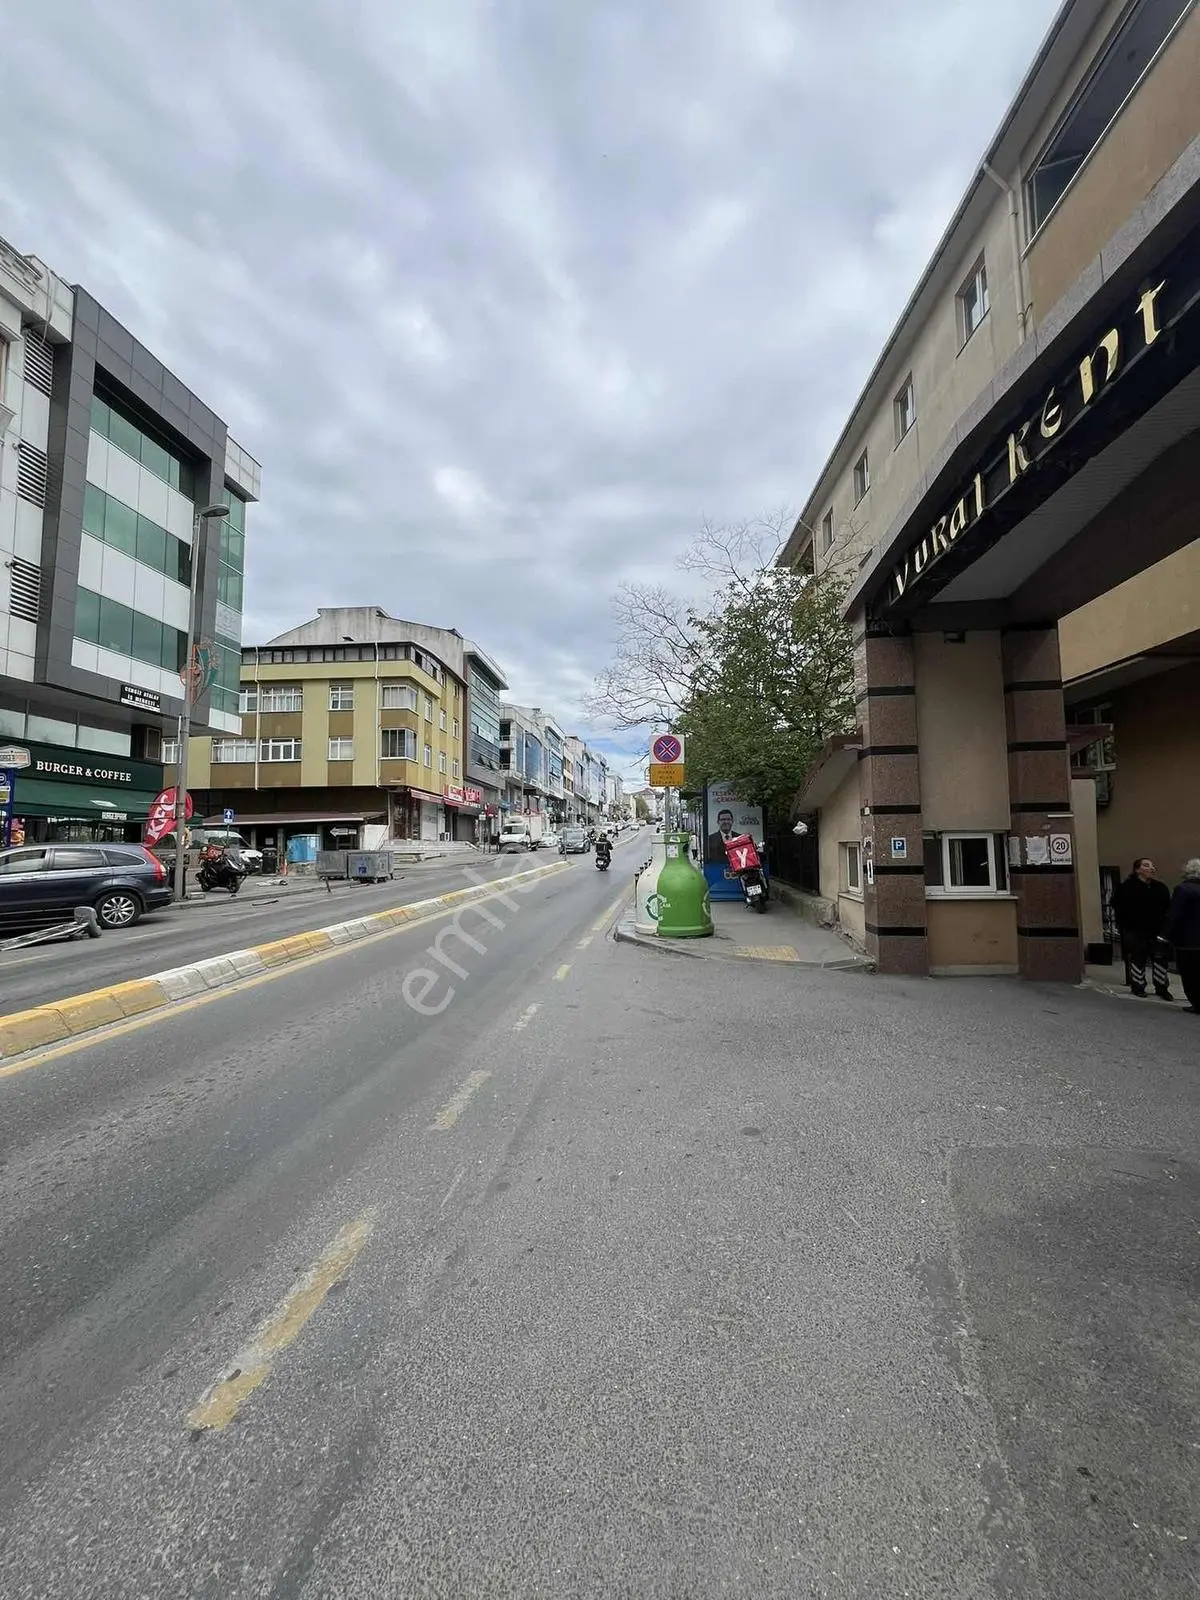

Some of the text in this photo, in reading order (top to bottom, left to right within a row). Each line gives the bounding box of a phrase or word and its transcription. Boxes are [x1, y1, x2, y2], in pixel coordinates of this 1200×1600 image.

[36, 760, 132, 783] BURGER & COFFEE
[895, 840, 903, 850] P
[1055, 841, 1066, 850] 20
